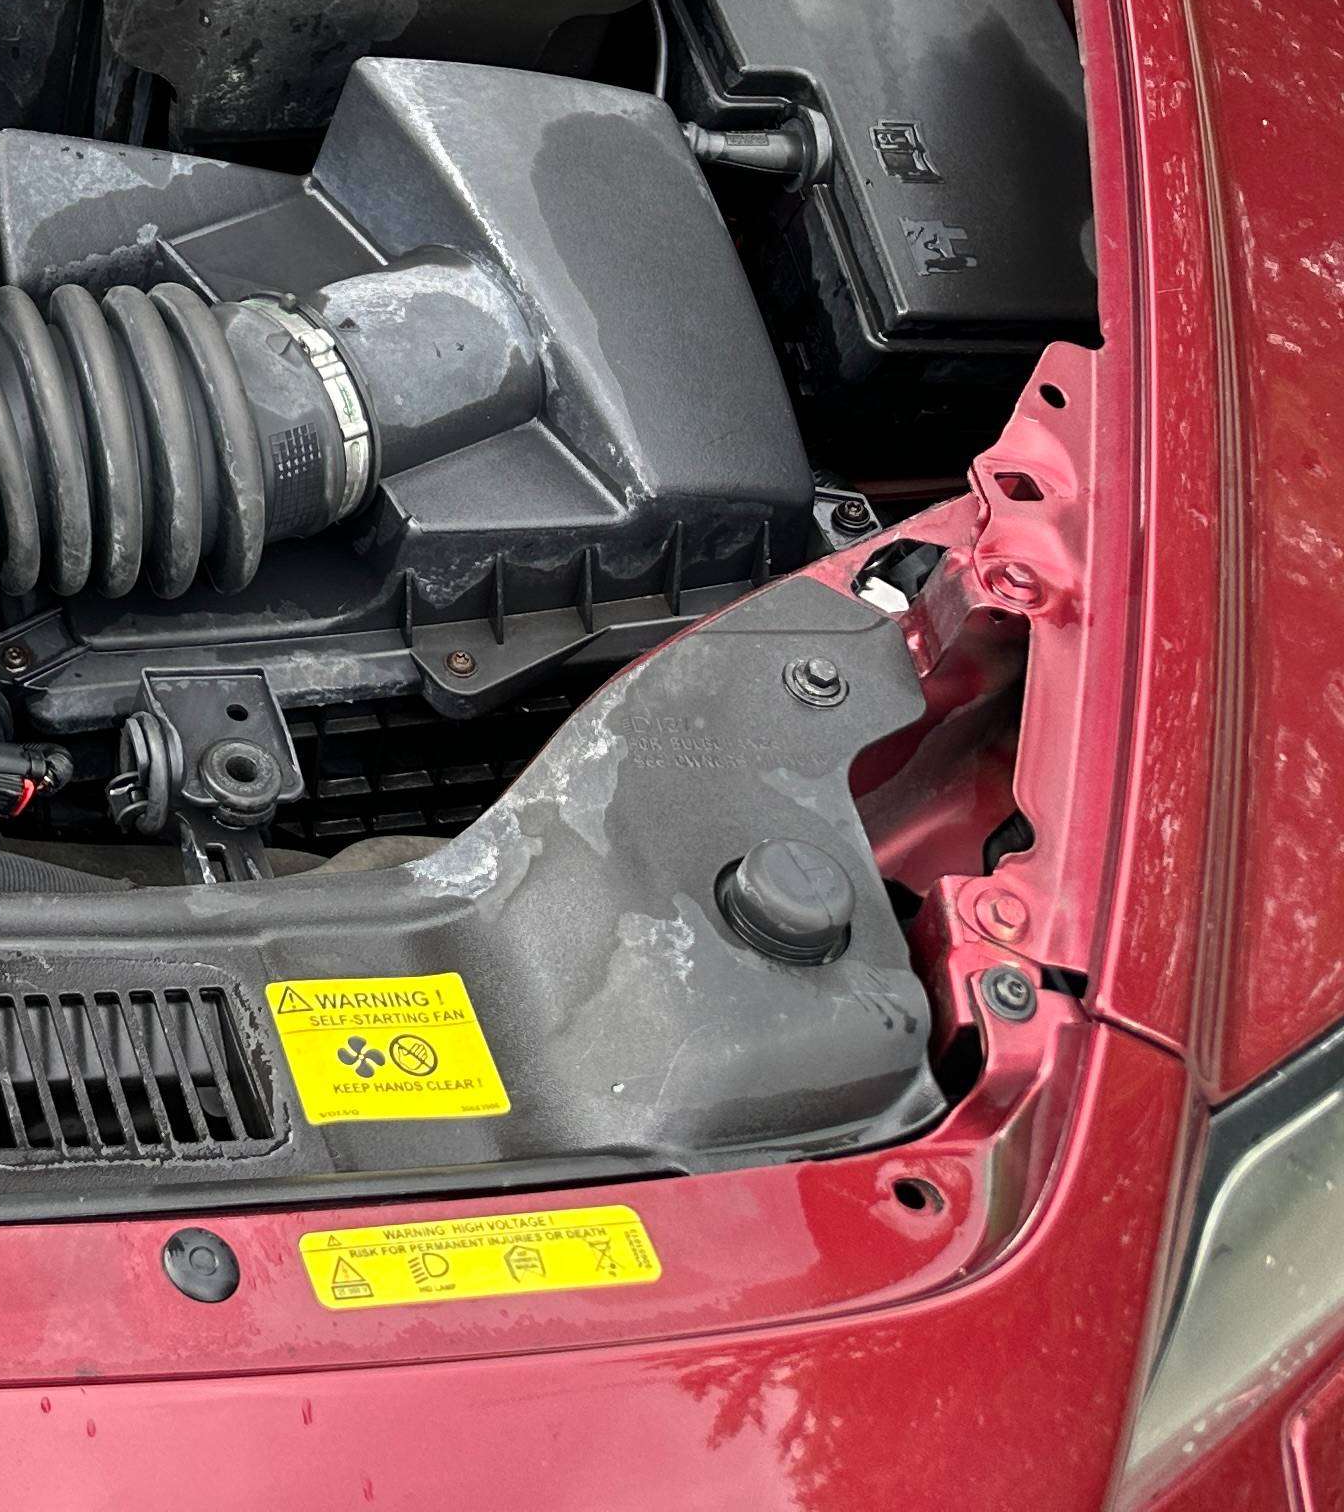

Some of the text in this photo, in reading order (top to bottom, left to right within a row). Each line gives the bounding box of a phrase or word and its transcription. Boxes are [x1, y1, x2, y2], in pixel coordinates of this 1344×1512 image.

[314, 989, 444, 1009] WARNING !
[309, 1009, 465, 1026] SELF-STARTING FAN
[333, 1081, 370, 1094] KEEP
[374, 1080, 421, 1093] HANDS
[426, 1079, 475, 1091] CLEAR
[318, 1109, 360, 1118] VOLVO
[382, 1225, 446, 1240] WARNING
[451, 1222, 485, 1234] HIGH
[486, 1216, 547, 1231] VOLTAGE
[348, 1226, 607, 1258] RISK FOR PERMANENT INJURIES OR DEATH
